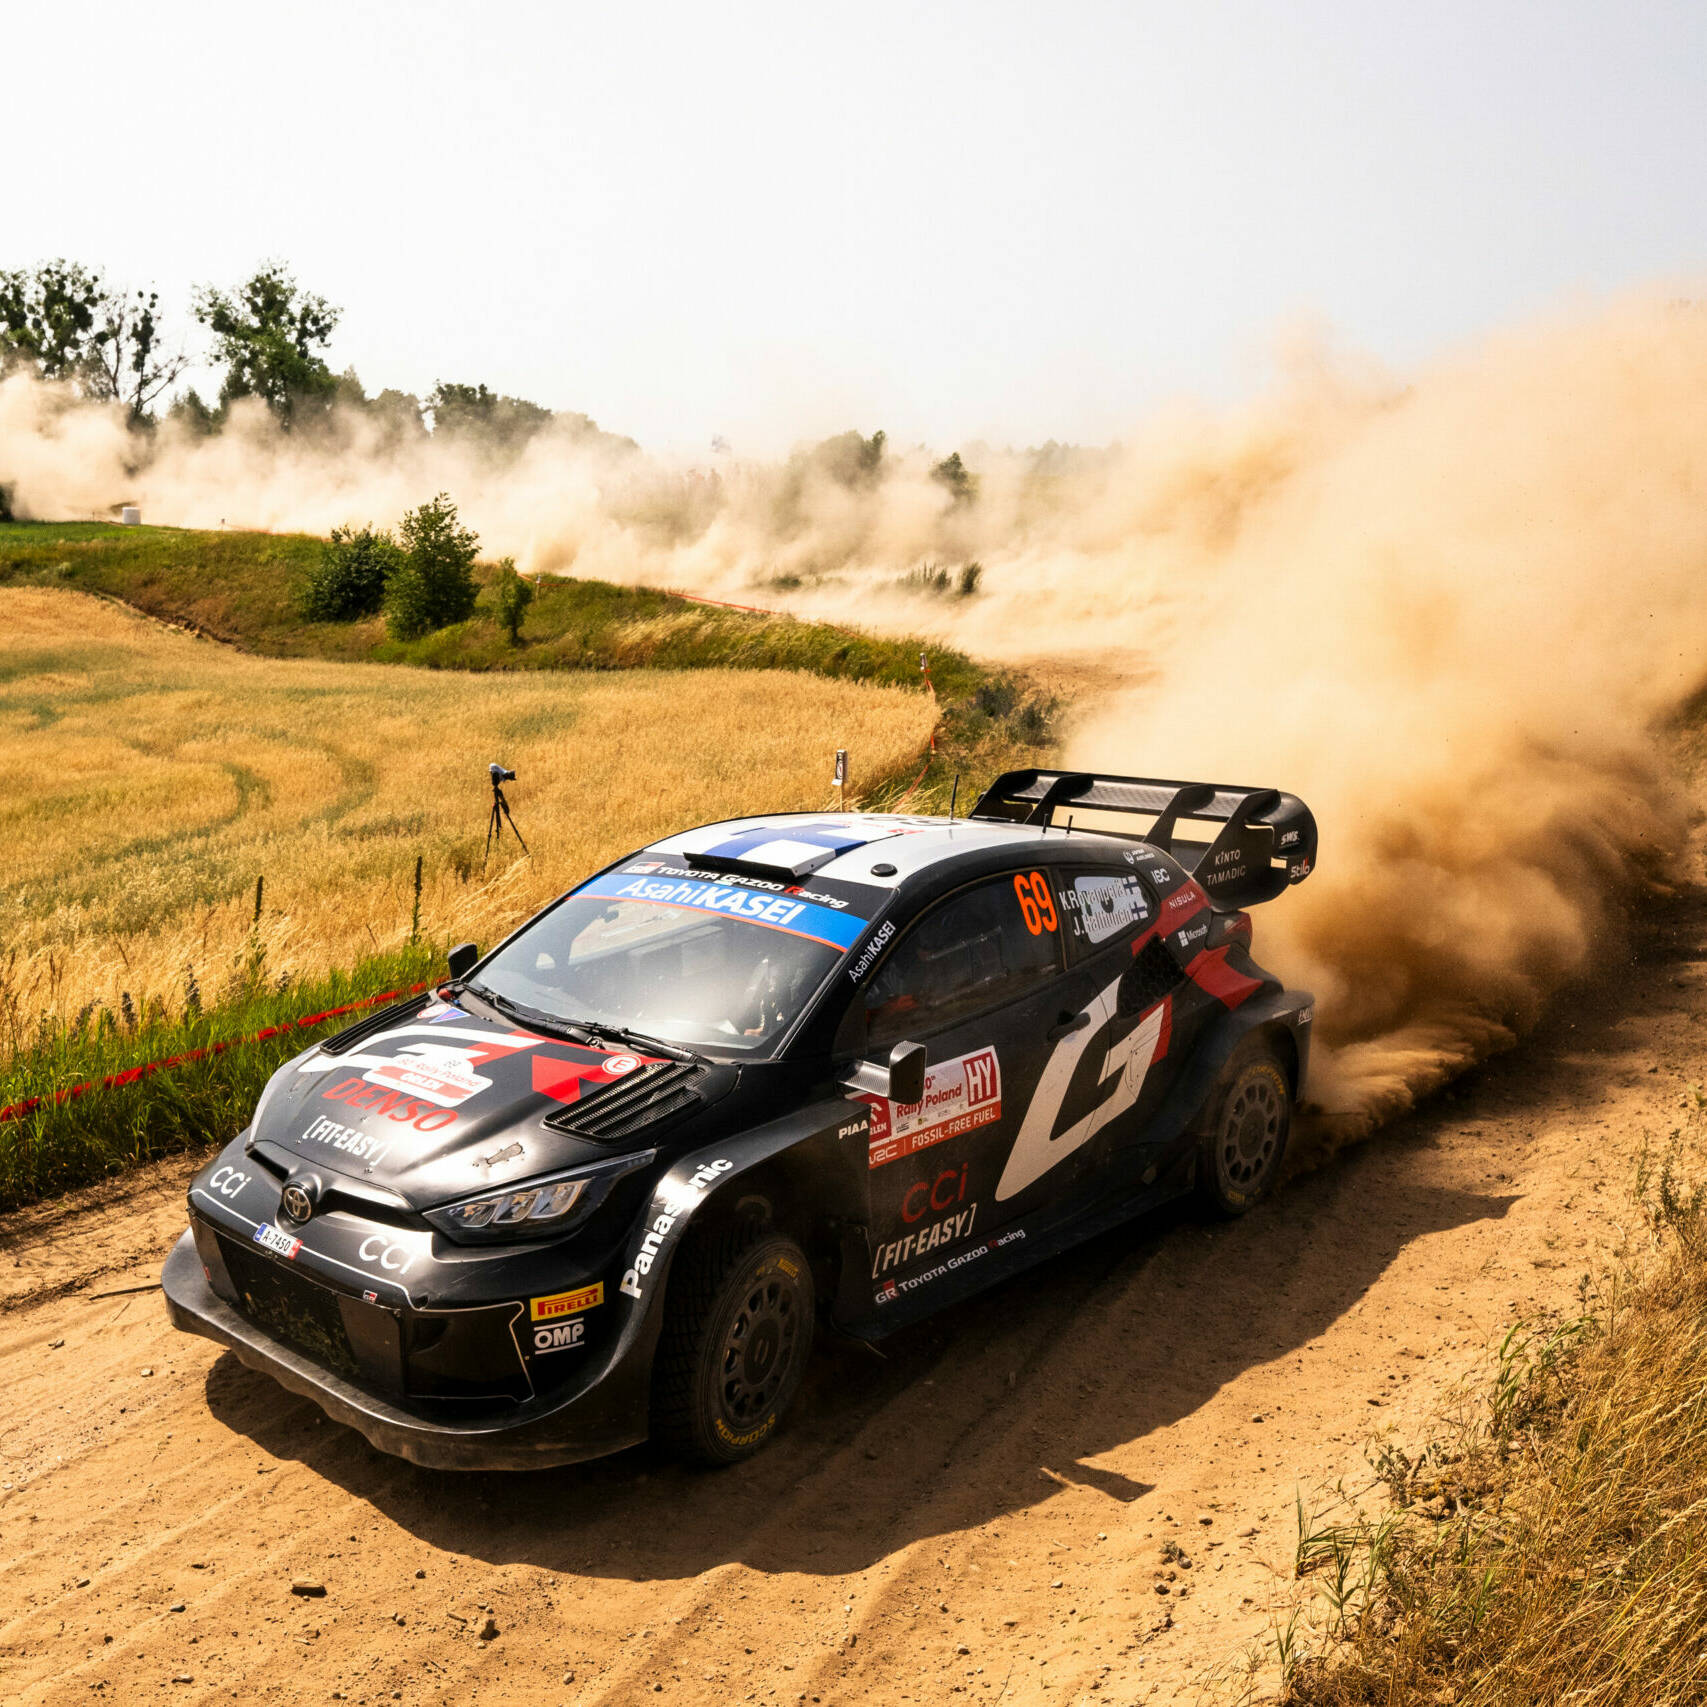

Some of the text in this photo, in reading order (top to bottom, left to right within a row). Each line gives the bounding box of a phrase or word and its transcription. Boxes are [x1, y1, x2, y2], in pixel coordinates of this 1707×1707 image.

[1215, 849, 1241, 866] KINTO
[657, 867, 720, 881] TOYOTA
[784, 885, 850, 909] Racing
[1207, 865, 1246, 886] TAMADIC
[1013, 871, 1058, 936] 69
[1168, 891, 1197, 909] NISULA
[848, 920, 897, 983] AsahiKASEI
[965, 1056, 993, 1104] HY
[321, 1077, 459, 1132] DENSO
[896, 1099, 924, 1119] Rally
[925, 1083, 963, 1109] Poland
[838, 1119, 869, 1140] PIAA
[911, 1115, 972, 1149] FOSSIL-FREE
[973, 1108, 996, 1127] FUEL
[262, 1230, 291, 1252] A-7450
[875, 1228, 1026, 1304] GR TOYOTA GAZOO Racing
[537, 1287, 599, 1316] PIRELLI
[534, 1323, 585, 1349] OMP
[715, 1412, 776, 1445] SCORPION
